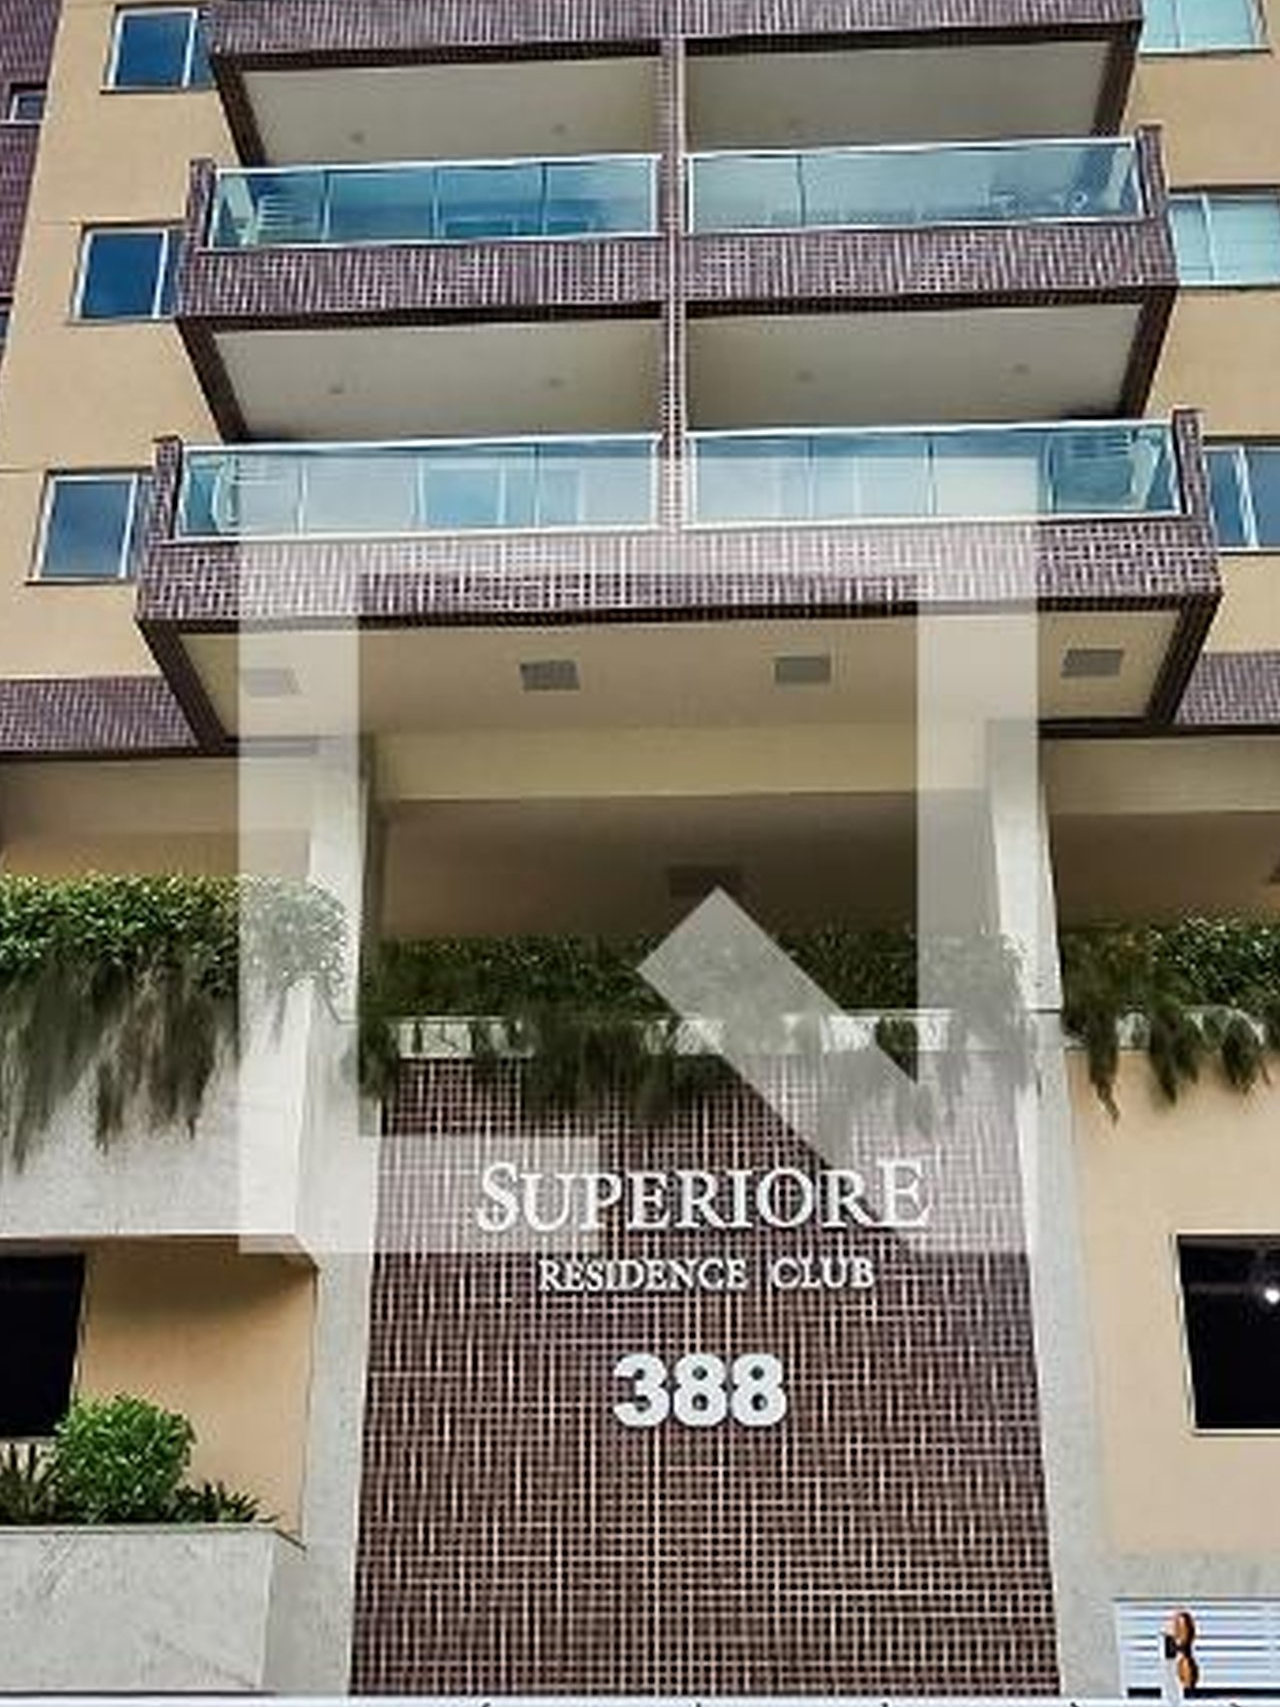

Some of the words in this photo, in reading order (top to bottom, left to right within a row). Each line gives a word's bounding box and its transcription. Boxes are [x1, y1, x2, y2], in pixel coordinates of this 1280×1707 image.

[476, 1158, 932, 1232] SUPERIORE
[538, 1258, 748, 1292] RESIDENCE
[772, 1256, 875, 1290] CLUB
[613, 1353, 787, 1427] 388
